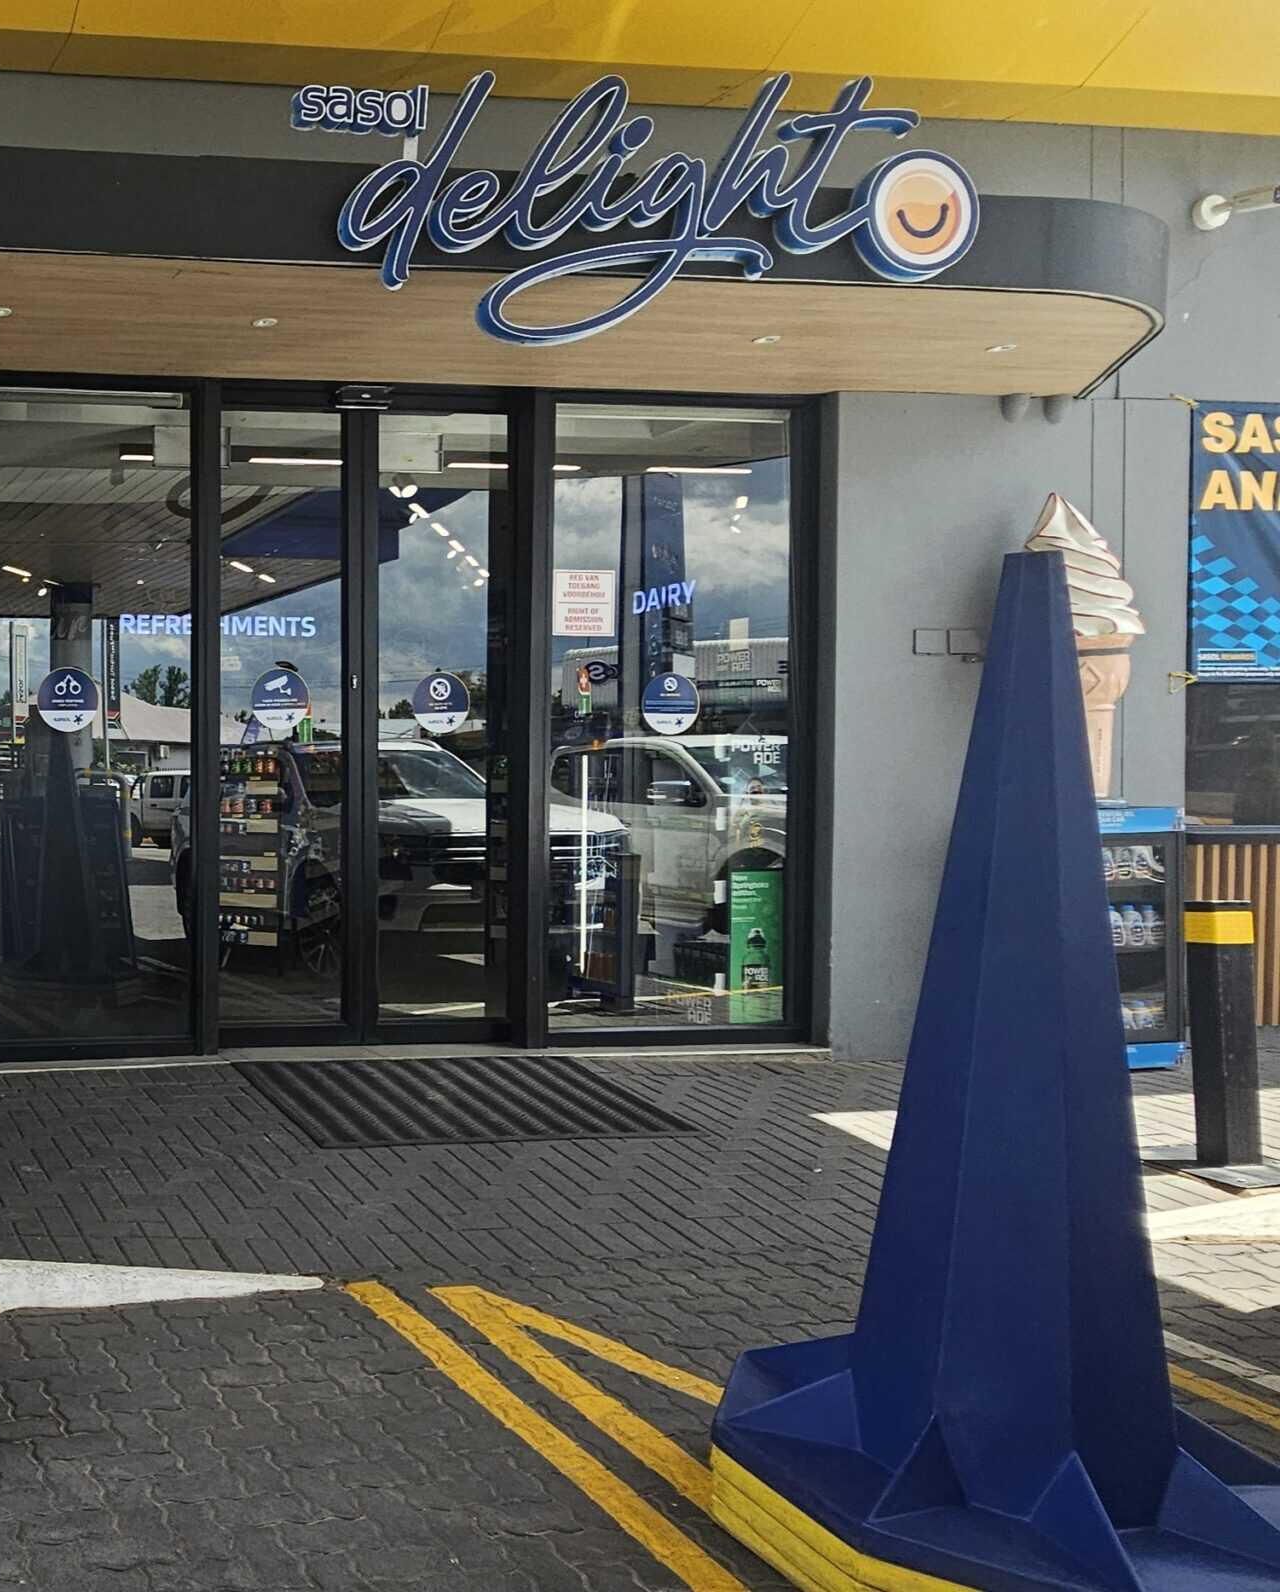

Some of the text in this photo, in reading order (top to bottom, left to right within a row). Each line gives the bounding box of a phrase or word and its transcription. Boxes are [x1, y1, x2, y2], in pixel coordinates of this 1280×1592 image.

[293, 84, 429, 135] sasol
[336, 69, 922, 346] delight
[1202, 411, 1280, 454] SA
[1200, 470, 1280, 511] AN
[632, 579, 696, 615] DAIRY
[120, 613, 317, 638] REFREHMENTS
[753, 751, 781, 764] ADE
